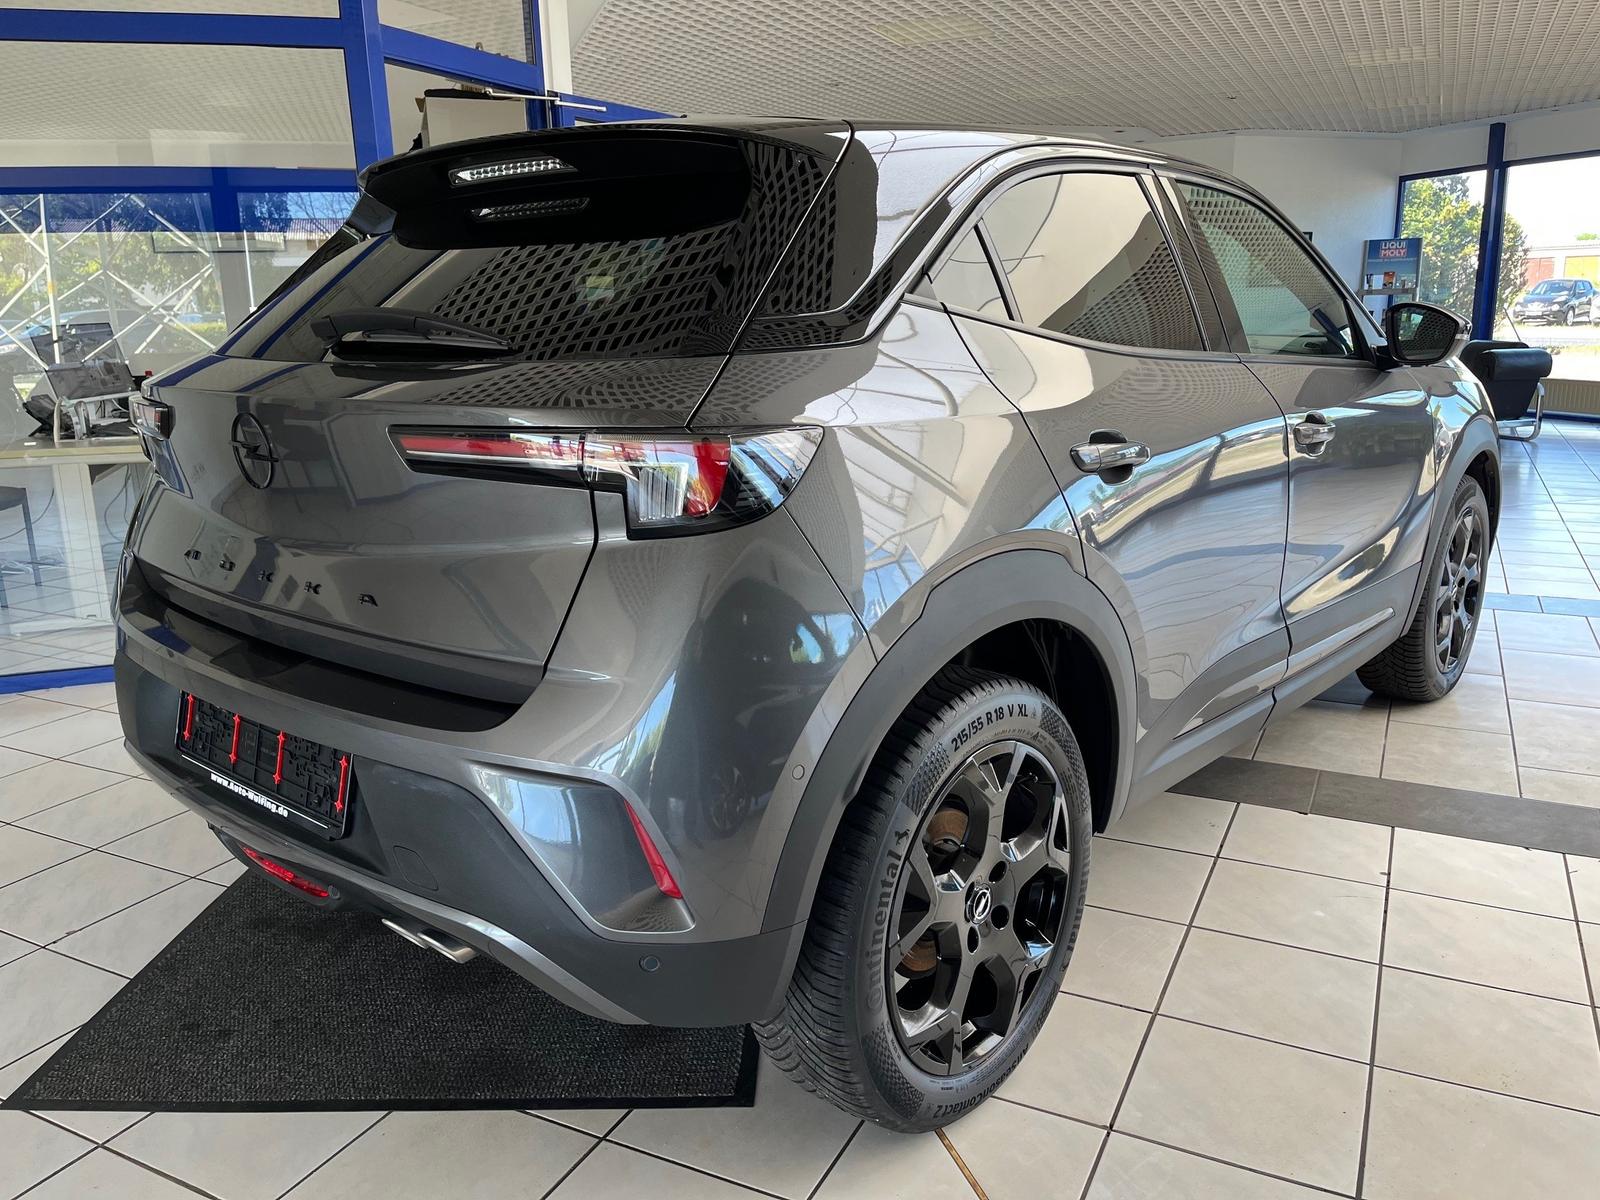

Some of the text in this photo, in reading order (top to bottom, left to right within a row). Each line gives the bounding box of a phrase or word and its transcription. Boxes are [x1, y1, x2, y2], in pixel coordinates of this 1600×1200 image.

[1381, 241, 1406, 249] LIQUI
[1381, 249, 1407, 257] MOLY
[951, 716, 984, 752] 215/55
[1007, 704, 1014, 717] V
[1017, 703, 1028, 717] XL
[932, 1105, 943, 1119] 2
